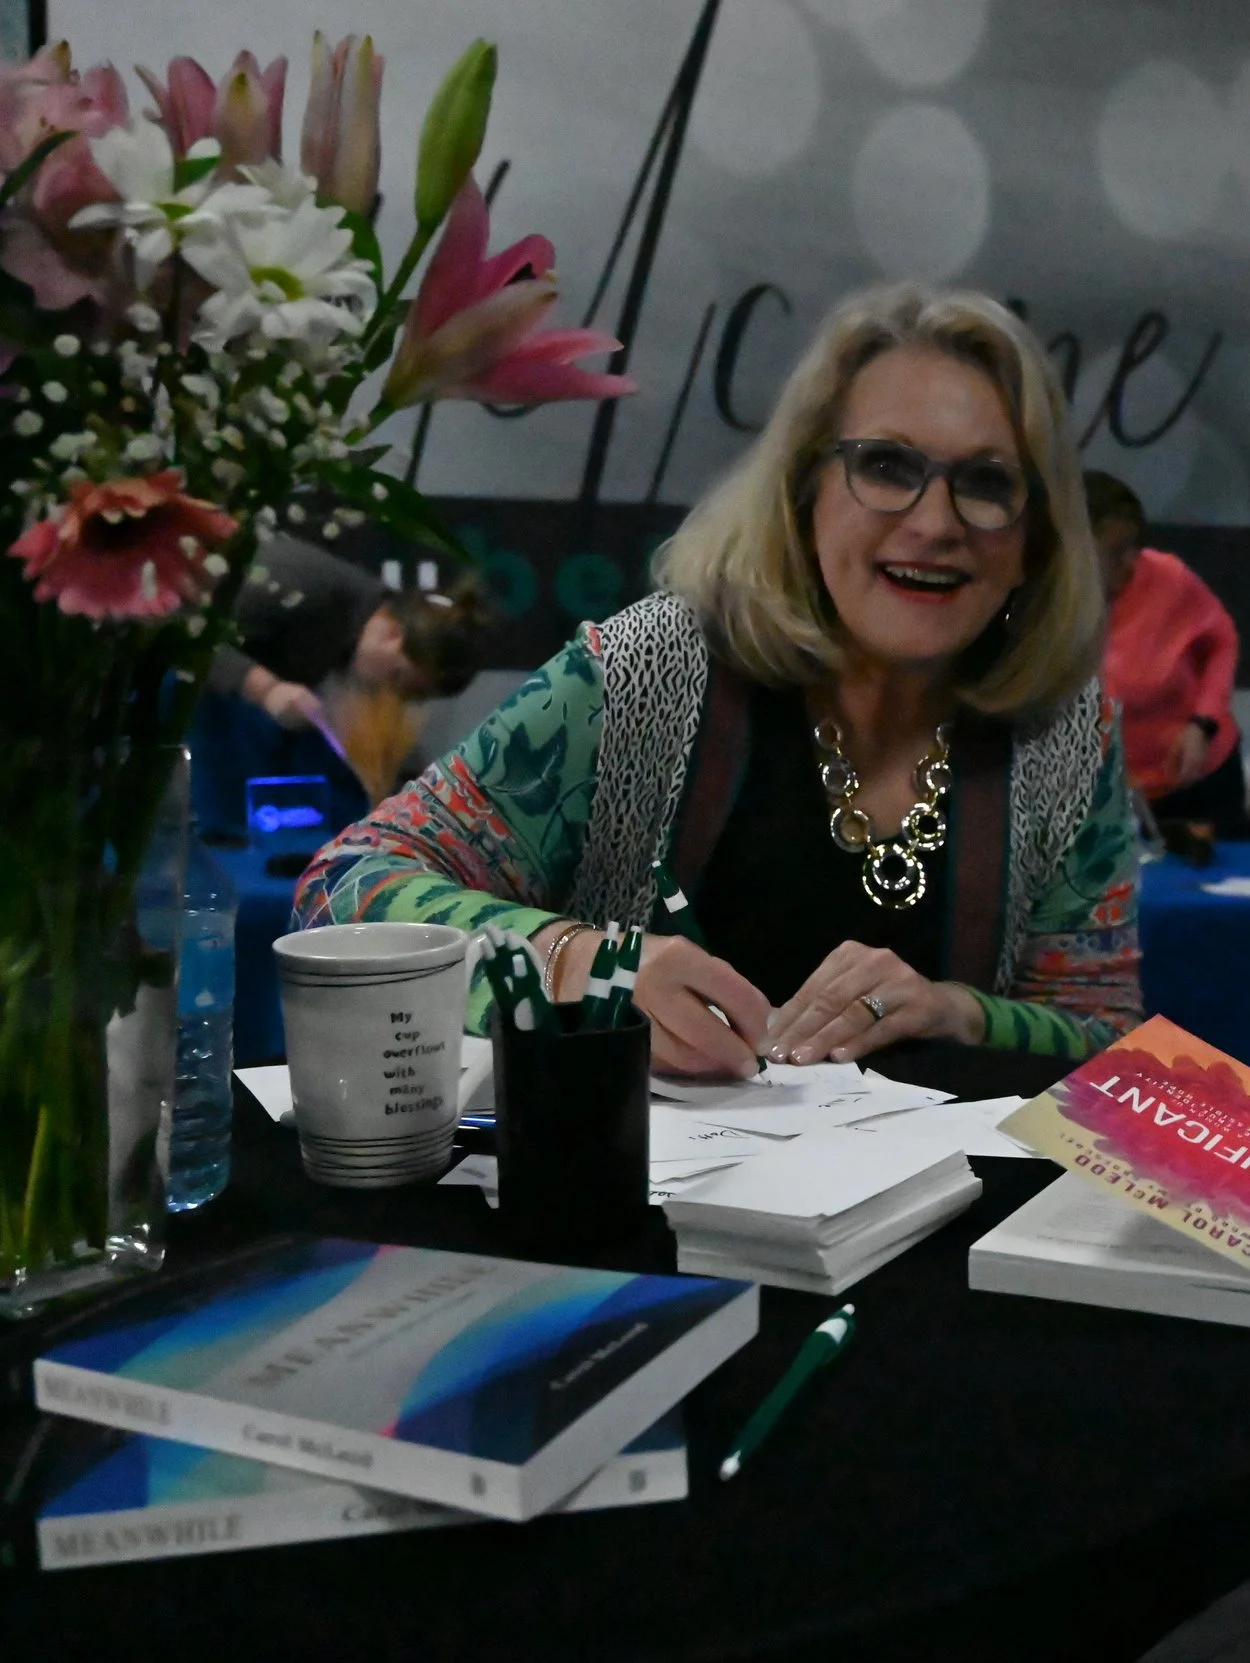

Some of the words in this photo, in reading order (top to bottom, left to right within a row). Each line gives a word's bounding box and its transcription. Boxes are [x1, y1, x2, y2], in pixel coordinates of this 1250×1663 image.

[390, 1012, 412, 1023] My
[395, 1031, 421, 1041] cup
[1200, 1108, 1232, 1127] TRUE
[245, 1264, 497, 1388] MEANWHILE
[53, 1513, 242, 1557] MEANWHILE
